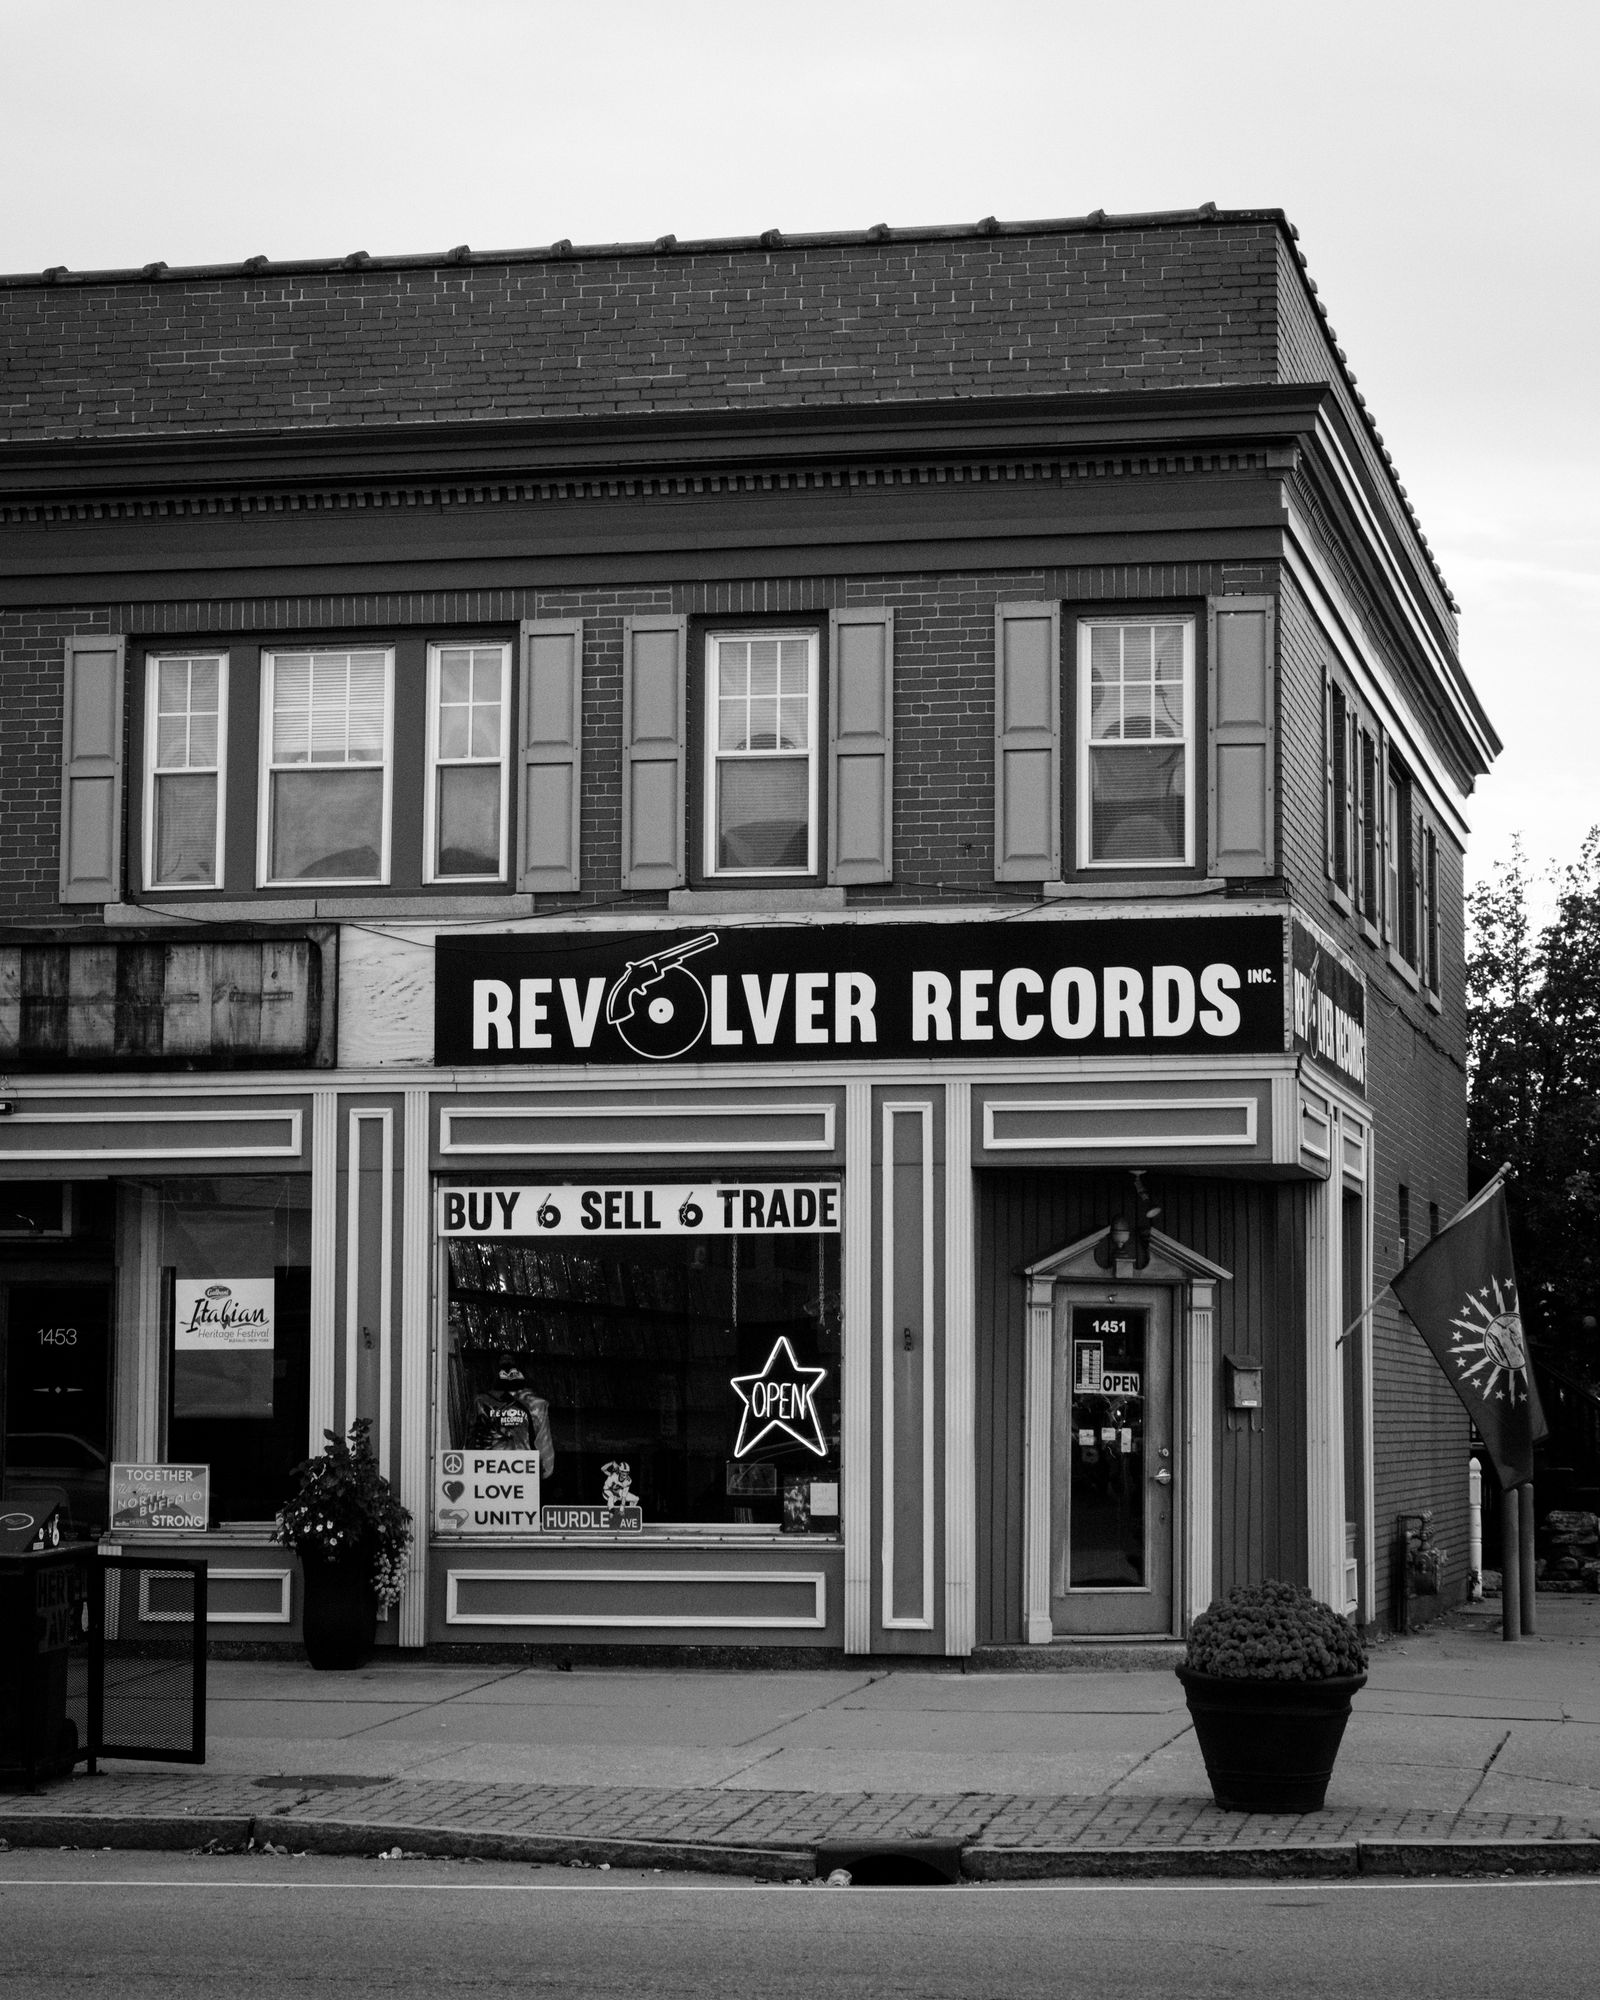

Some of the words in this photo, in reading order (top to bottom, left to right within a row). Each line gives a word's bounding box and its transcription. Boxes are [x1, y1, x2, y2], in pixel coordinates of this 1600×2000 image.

[473, 962, 878, 1058] REVOLVER
[912, 963, 1241, 1041] RECORDS
[1247, 968, 1277, 984] INC.
[443, 1191, 521, 1231] BUY
[580, 1190, 661, 1230] SELL
[717, 1188, 838, 1229] TRADE
[186, 1298, 267, 1333] Italian
[198, 1329, 235, 1340] Heritage
[237, 1328, 269, 1338] Festival
[1092, 1320, 1126, 1333] 1451
[37, 1328, 78, 1345] 1453
[1102, 1375, 1138, 1392] OPEN
[752, 1381, 807, 1420] OPEN
[126, 1469, 194, 1481] TOGETHER
[474, 1459, 536, 1474] PEACE
[117, 1490, 166, 1510] NORTH
[474, 1484, 524, 1499] LOVE
[139, 1491, 202, 1517] BUFFALO
[151, 1514, 204, 1527] STRONG
[474, 1510, 537, 1525] UNITY
[546, 1511, 610, 1528] HURDLE
[620, 1518, 638, 1528] AVE
